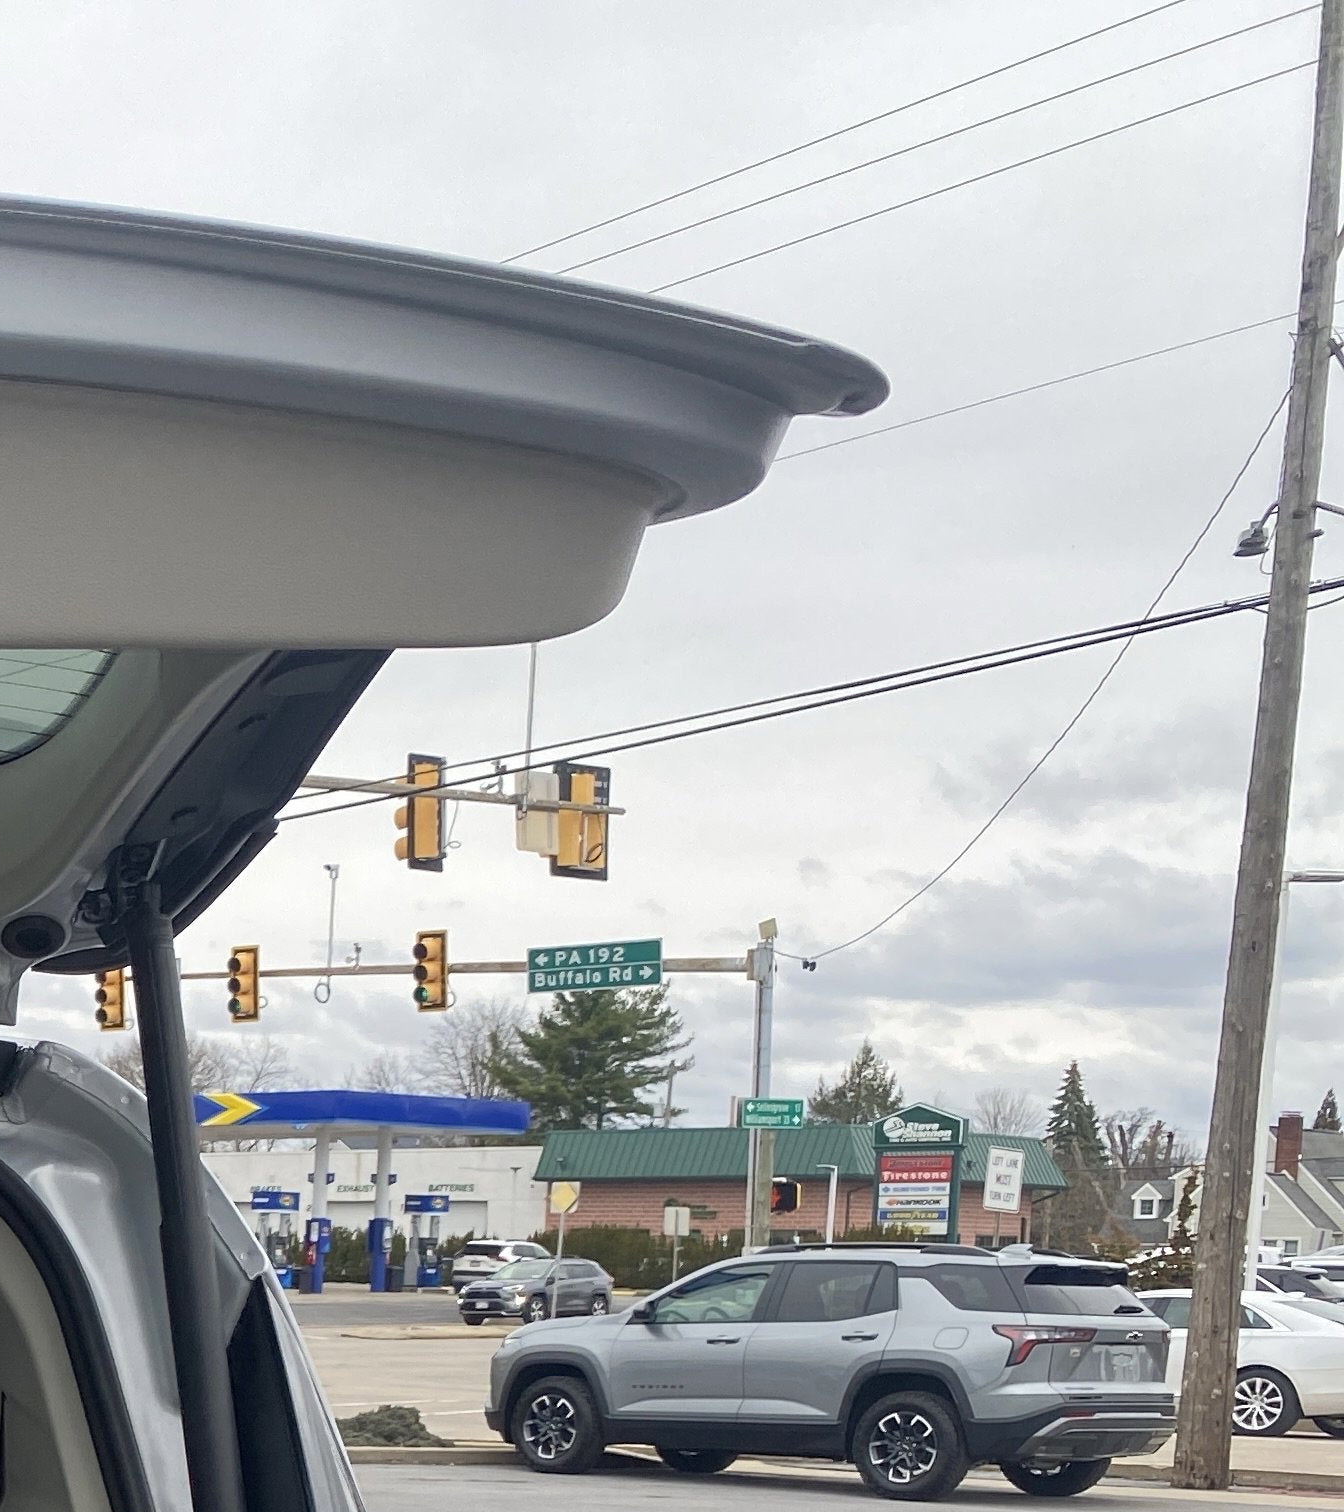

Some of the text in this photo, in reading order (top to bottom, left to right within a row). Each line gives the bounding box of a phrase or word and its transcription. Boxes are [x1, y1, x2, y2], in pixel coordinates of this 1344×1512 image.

[555, 947, 624, 966] PA 192
[534, 966, 633, 988] Buffalo Rd
[881, 1171, 948, 1181] Firestone
[428, 1183, 475, 1193] BATTERIES
